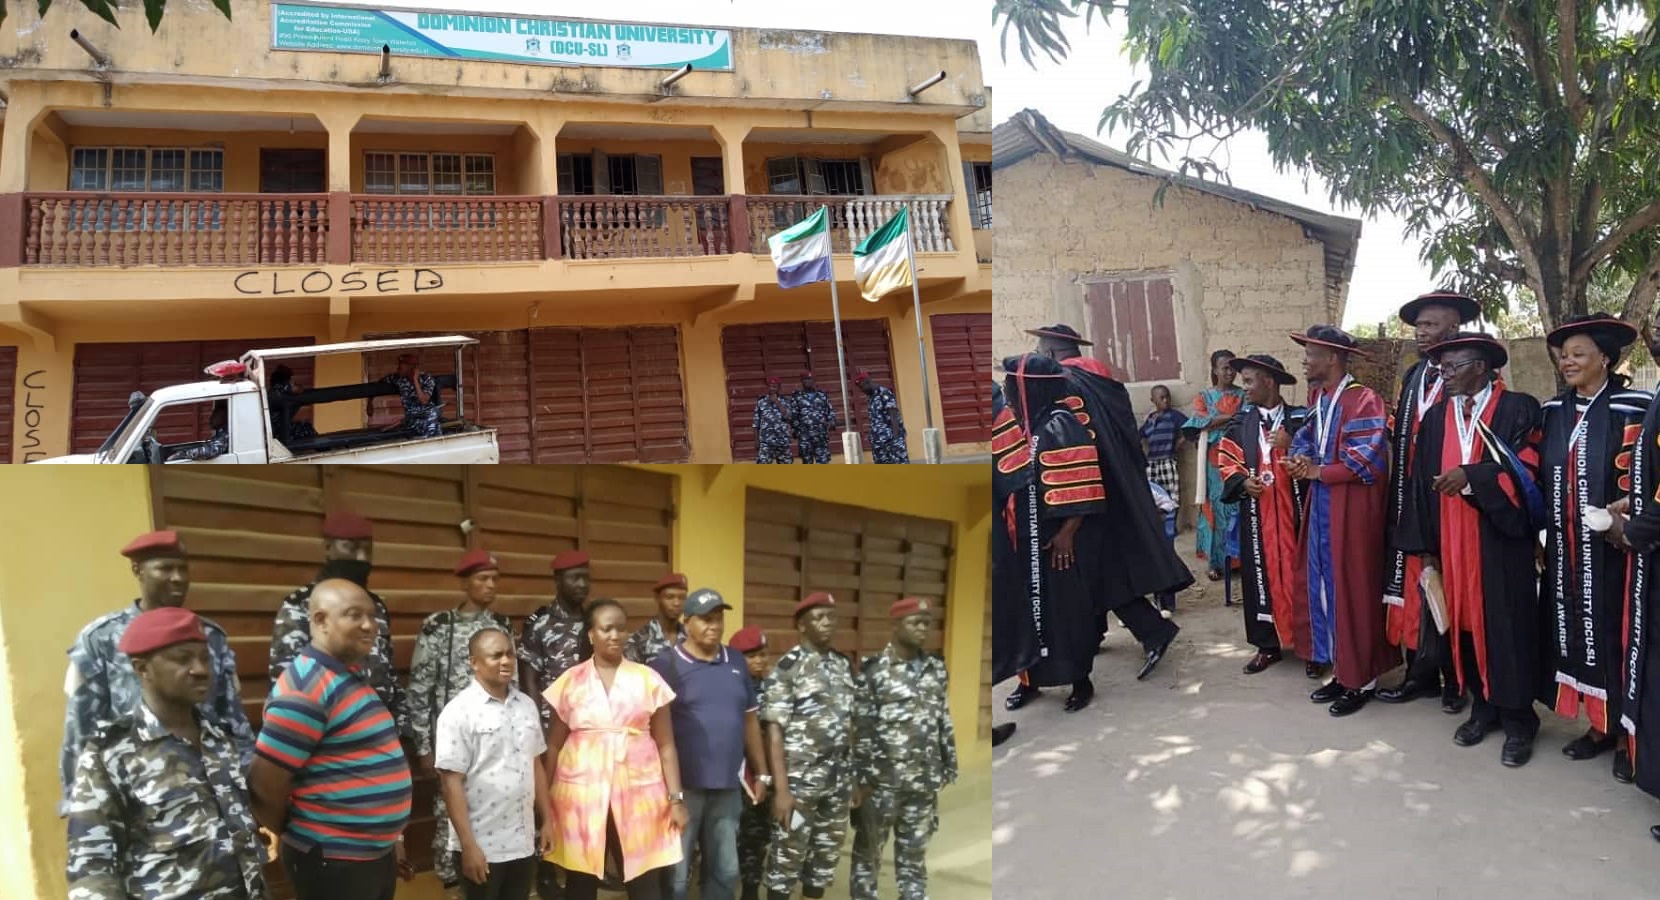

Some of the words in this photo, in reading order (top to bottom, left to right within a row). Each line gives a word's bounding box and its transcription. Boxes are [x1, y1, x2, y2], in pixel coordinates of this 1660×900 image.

[417, 13, 511, 34] DOMINION
[516, 18, 612, 40] CHRISTIAN
[614, 25, 718, 45] UNIVERSITY
[550, 40, 608, 57] (DCU-SL)
[234, 268, 443, 295] CLOSED
[1577, 420, 1589, 476] DOMINION
[1028, 484, 1039, 537] CHRISTIAN
[1552, 465, 1563, 528] HONORARY
[1030, 538, 1041, 594] UNIVERSITY
[1251, 516, 1261, 565] DOCTORATE
[1555, 532, 1564, 599] DOCTORATE
[1582, 544, 1593, 614] UNIVERSITY
[1556, 602, 1568, 658] AWARDEE
[1633, 571, 1644, 645] UNIVERSITY
[1582, 616, 1596, 666] (DCU-SL)
